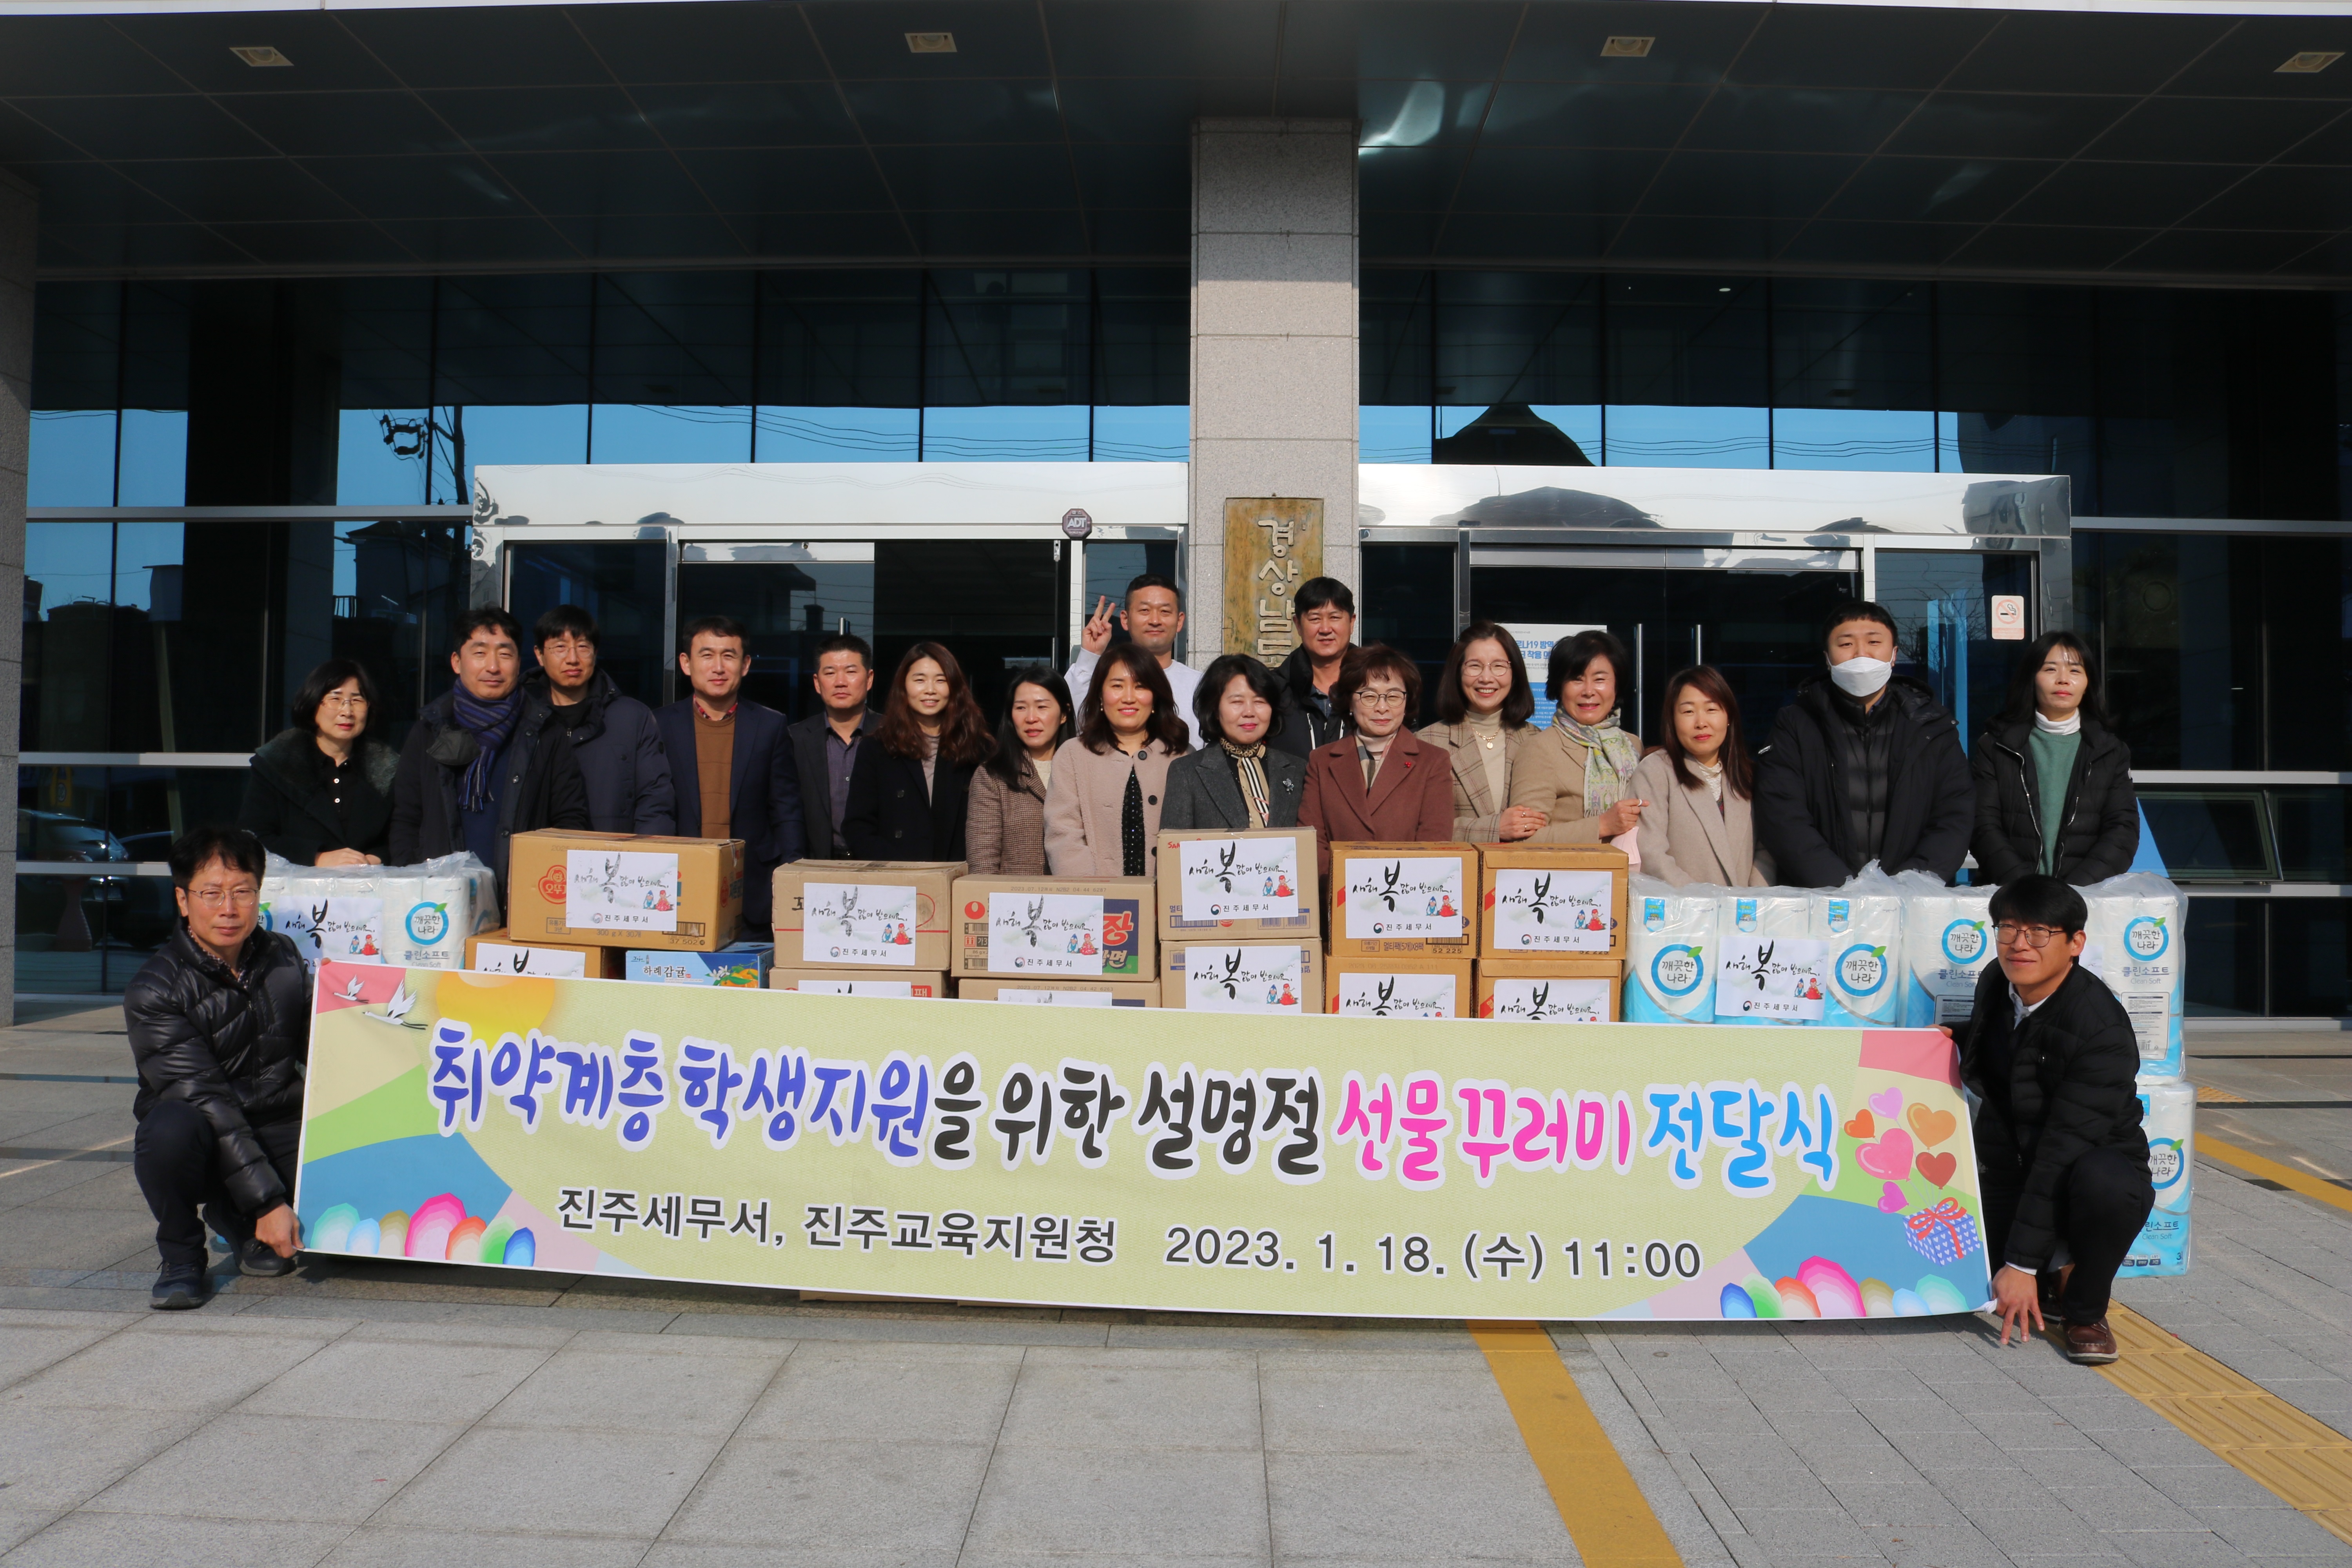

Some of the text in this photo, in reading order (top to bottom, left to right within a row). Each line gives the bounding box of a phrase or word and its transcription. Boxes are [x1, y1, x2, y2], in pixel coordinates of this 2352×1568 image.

[1067, 518, 1087, 528] ADT
[1515, 641, 1539, 649] 로나19
[1527, 650, 1541, 659] 착용
[1189, 859, 1214, 876] 새해
[1215, 841, 1236, 894] 복
[1236, 864, 1252, 875] 많이
[1353, 877, 1377, 894] 새해
[1379, 860, 1400, 913] 복
[1400, 883, 1416, 894] 많이
[1502, 888, 1527, 904] 새해
[1528, 872, 1551, 924] 복
[1550, 895, 1565, 907] 많이
[837, 886, 858, 936] 복
[306, 898, 328, 949] 복
[414, 915, 440, 924] 깨끗한
[1022, 895, 1044, 947] 복
[418, 926, 436, 935] 나라
[1103, 913, 1133, 946] 장
[2132, 930, 2160, 940] 깨끗한
[1950, 933, 1979, 943] 깨끗한
[1955, 944, 1974, 953] 나라
[2137, 941, 2156, 950] 나라
[404, 951, 450, 960] 클린소프트
[1662, 960, 1694, 972] 깨끗한
[1726, 955, 1750, 970] 새해
[1751, 939, 1774, 991] 복
[1772, 963, 1788, 974] 많이
[1846, 960, 1878, 972] 깨끗한
[1194, 964, 1218, 981] 새해
[1220, 947, 1241, 1000] 복
[1241, 971, 1257, 982] 많이
[2122, 967, 2170, 977] 클린소프트
[1667, 973, 1688, 984] 나라
[1851, 973, 1872, 984] 나라
[1347, 992, 1371, 1007] 새해
[1394, 998, 1409, 1010] 많이
[1501, 998, 1525, 1013] 새해
[1548, 1004, 1564, 1014] 많이
[433, 1027, 1833, 1189] 취약계층 학생지원을 위한 설명절 선물 꾸러미 전달식
[2141, 1221, 2179, 1232] 린소프트
[559, 1188, 1700, 1280] 진주세무서, 진주교육지원청 2023. 1. 18. (수) 11:00
